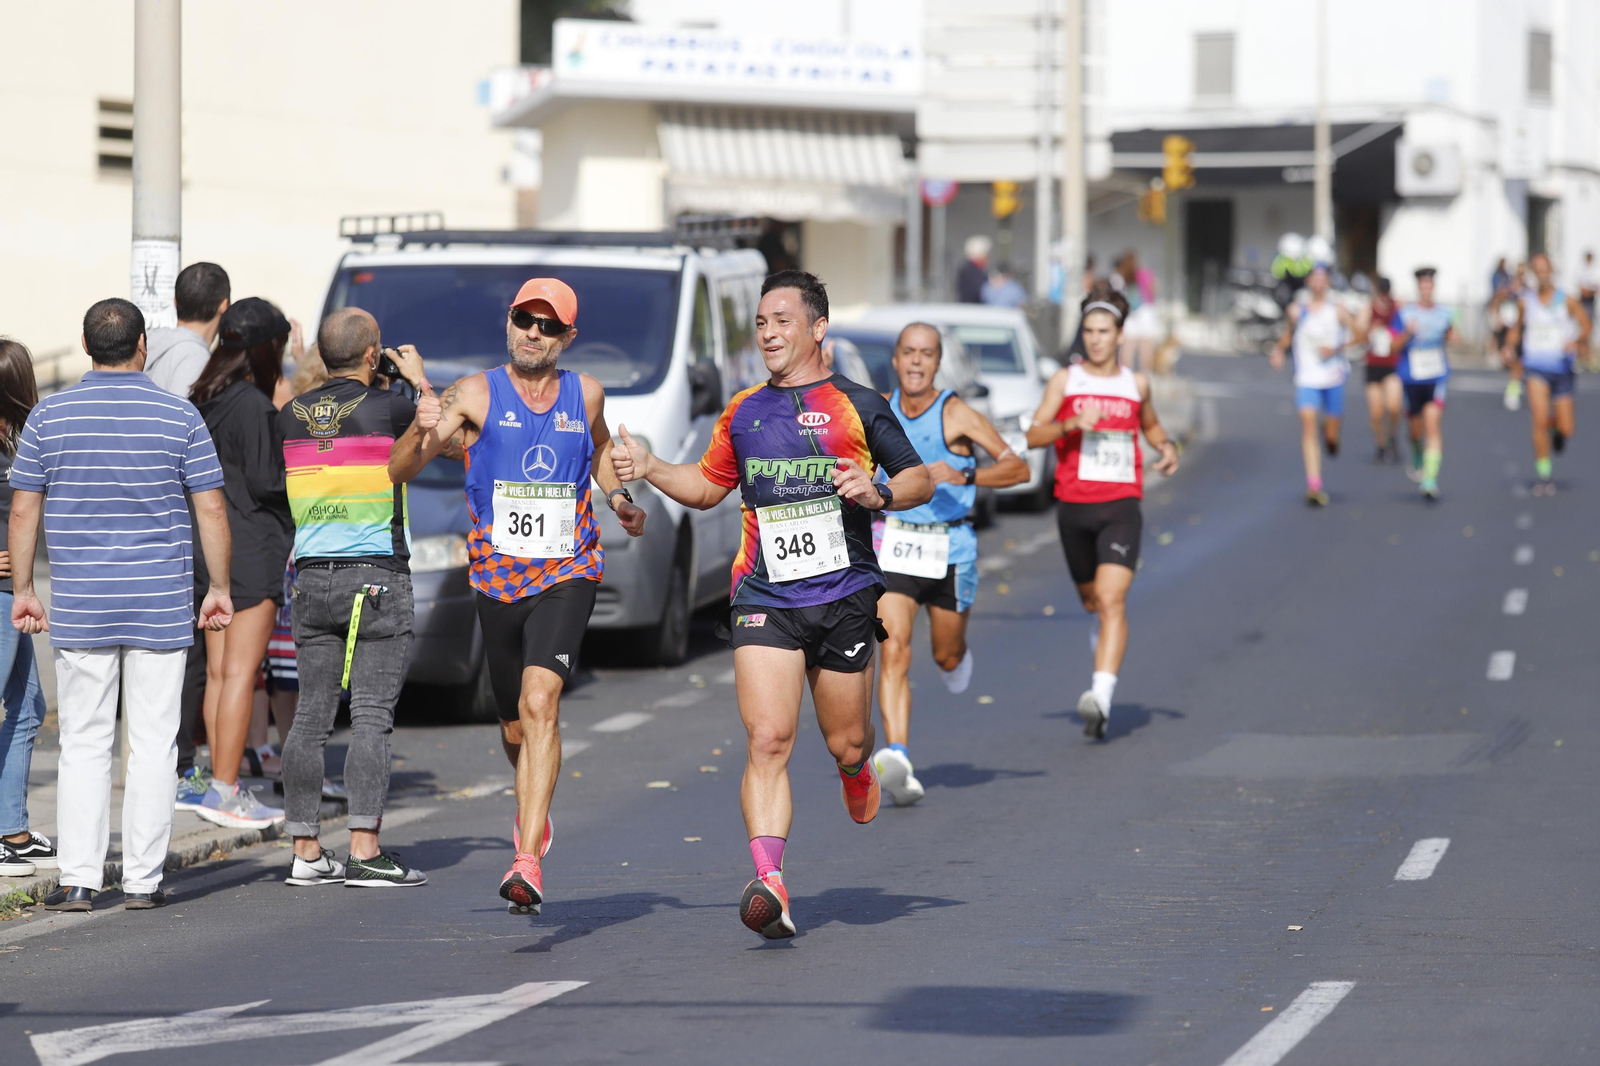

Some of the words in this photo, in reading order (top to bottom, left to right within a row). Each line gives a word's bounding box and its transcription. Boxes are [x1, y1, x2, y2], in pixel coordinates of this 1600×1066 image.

[641, 58, 777, 79] PATATAS
[789, 64, 893, 84] FRITAS
[498, 420, 522, 428] VIATOR
[802, 414, 826, 424] KIA
[798, 428, 828, 436] VEYSER
[508, 486, 535, 497] VUELTA
[537, 487, 543, 497] A
[545, 487, 571, 498] HUELVA
[762, 511, 771, 521] 34
[771, 507, 798, 521] VUELTA
[798, 508, 805, 517] A
[805, 500, 835, 515] HUELVA
[508, 511, 545, 538] 361
[784, 519, 809, 528] CARLOS
[774, 532, 816, 561] 348
[893, 541, 922, 560] 671
